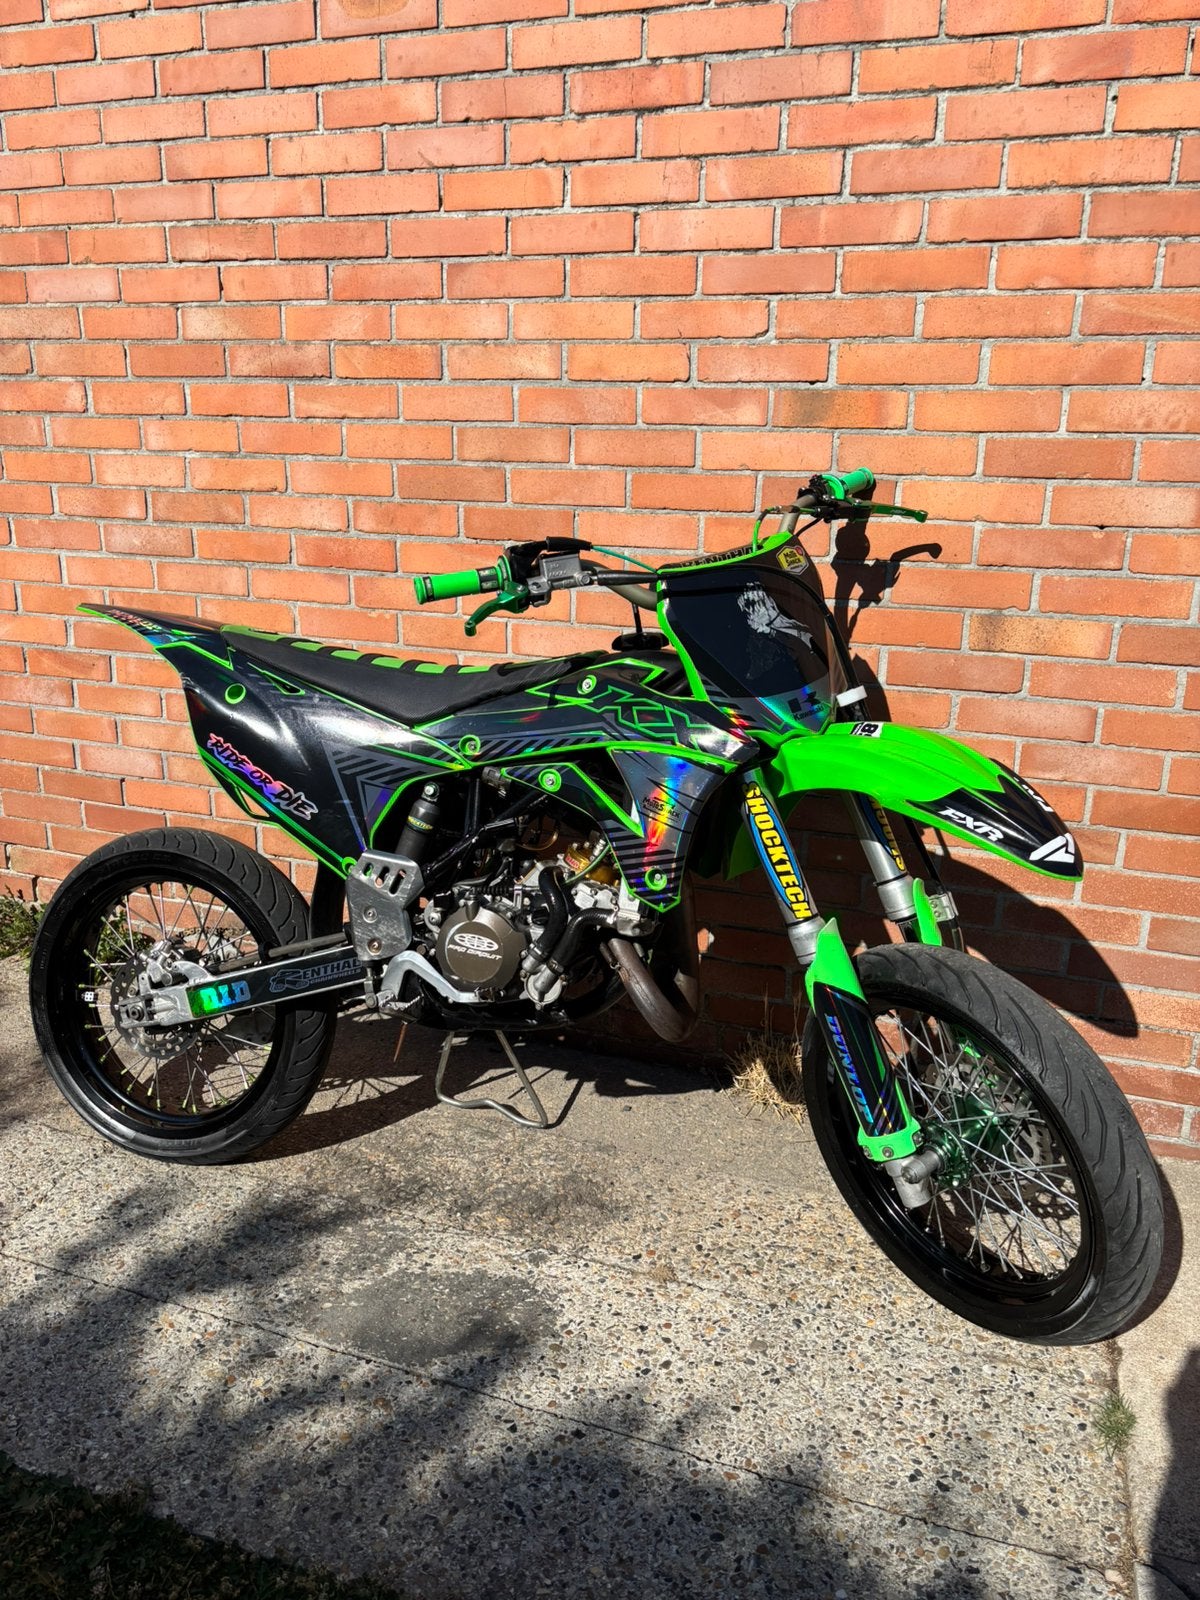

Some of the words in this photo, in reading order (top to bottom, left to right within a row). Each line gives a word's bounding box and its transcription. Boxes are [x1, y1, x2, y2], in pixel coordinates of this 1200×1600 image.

[207, 733, 253, 768] RIDE
[248, 765, 274, 789] OR
[268, 781, 319, 820] DIE
[938, 806, 1004, 841] FXR
[742, 781, 813, 920] SHOCKTECH
[824, 1012, 874, 1125] DUNLOP
